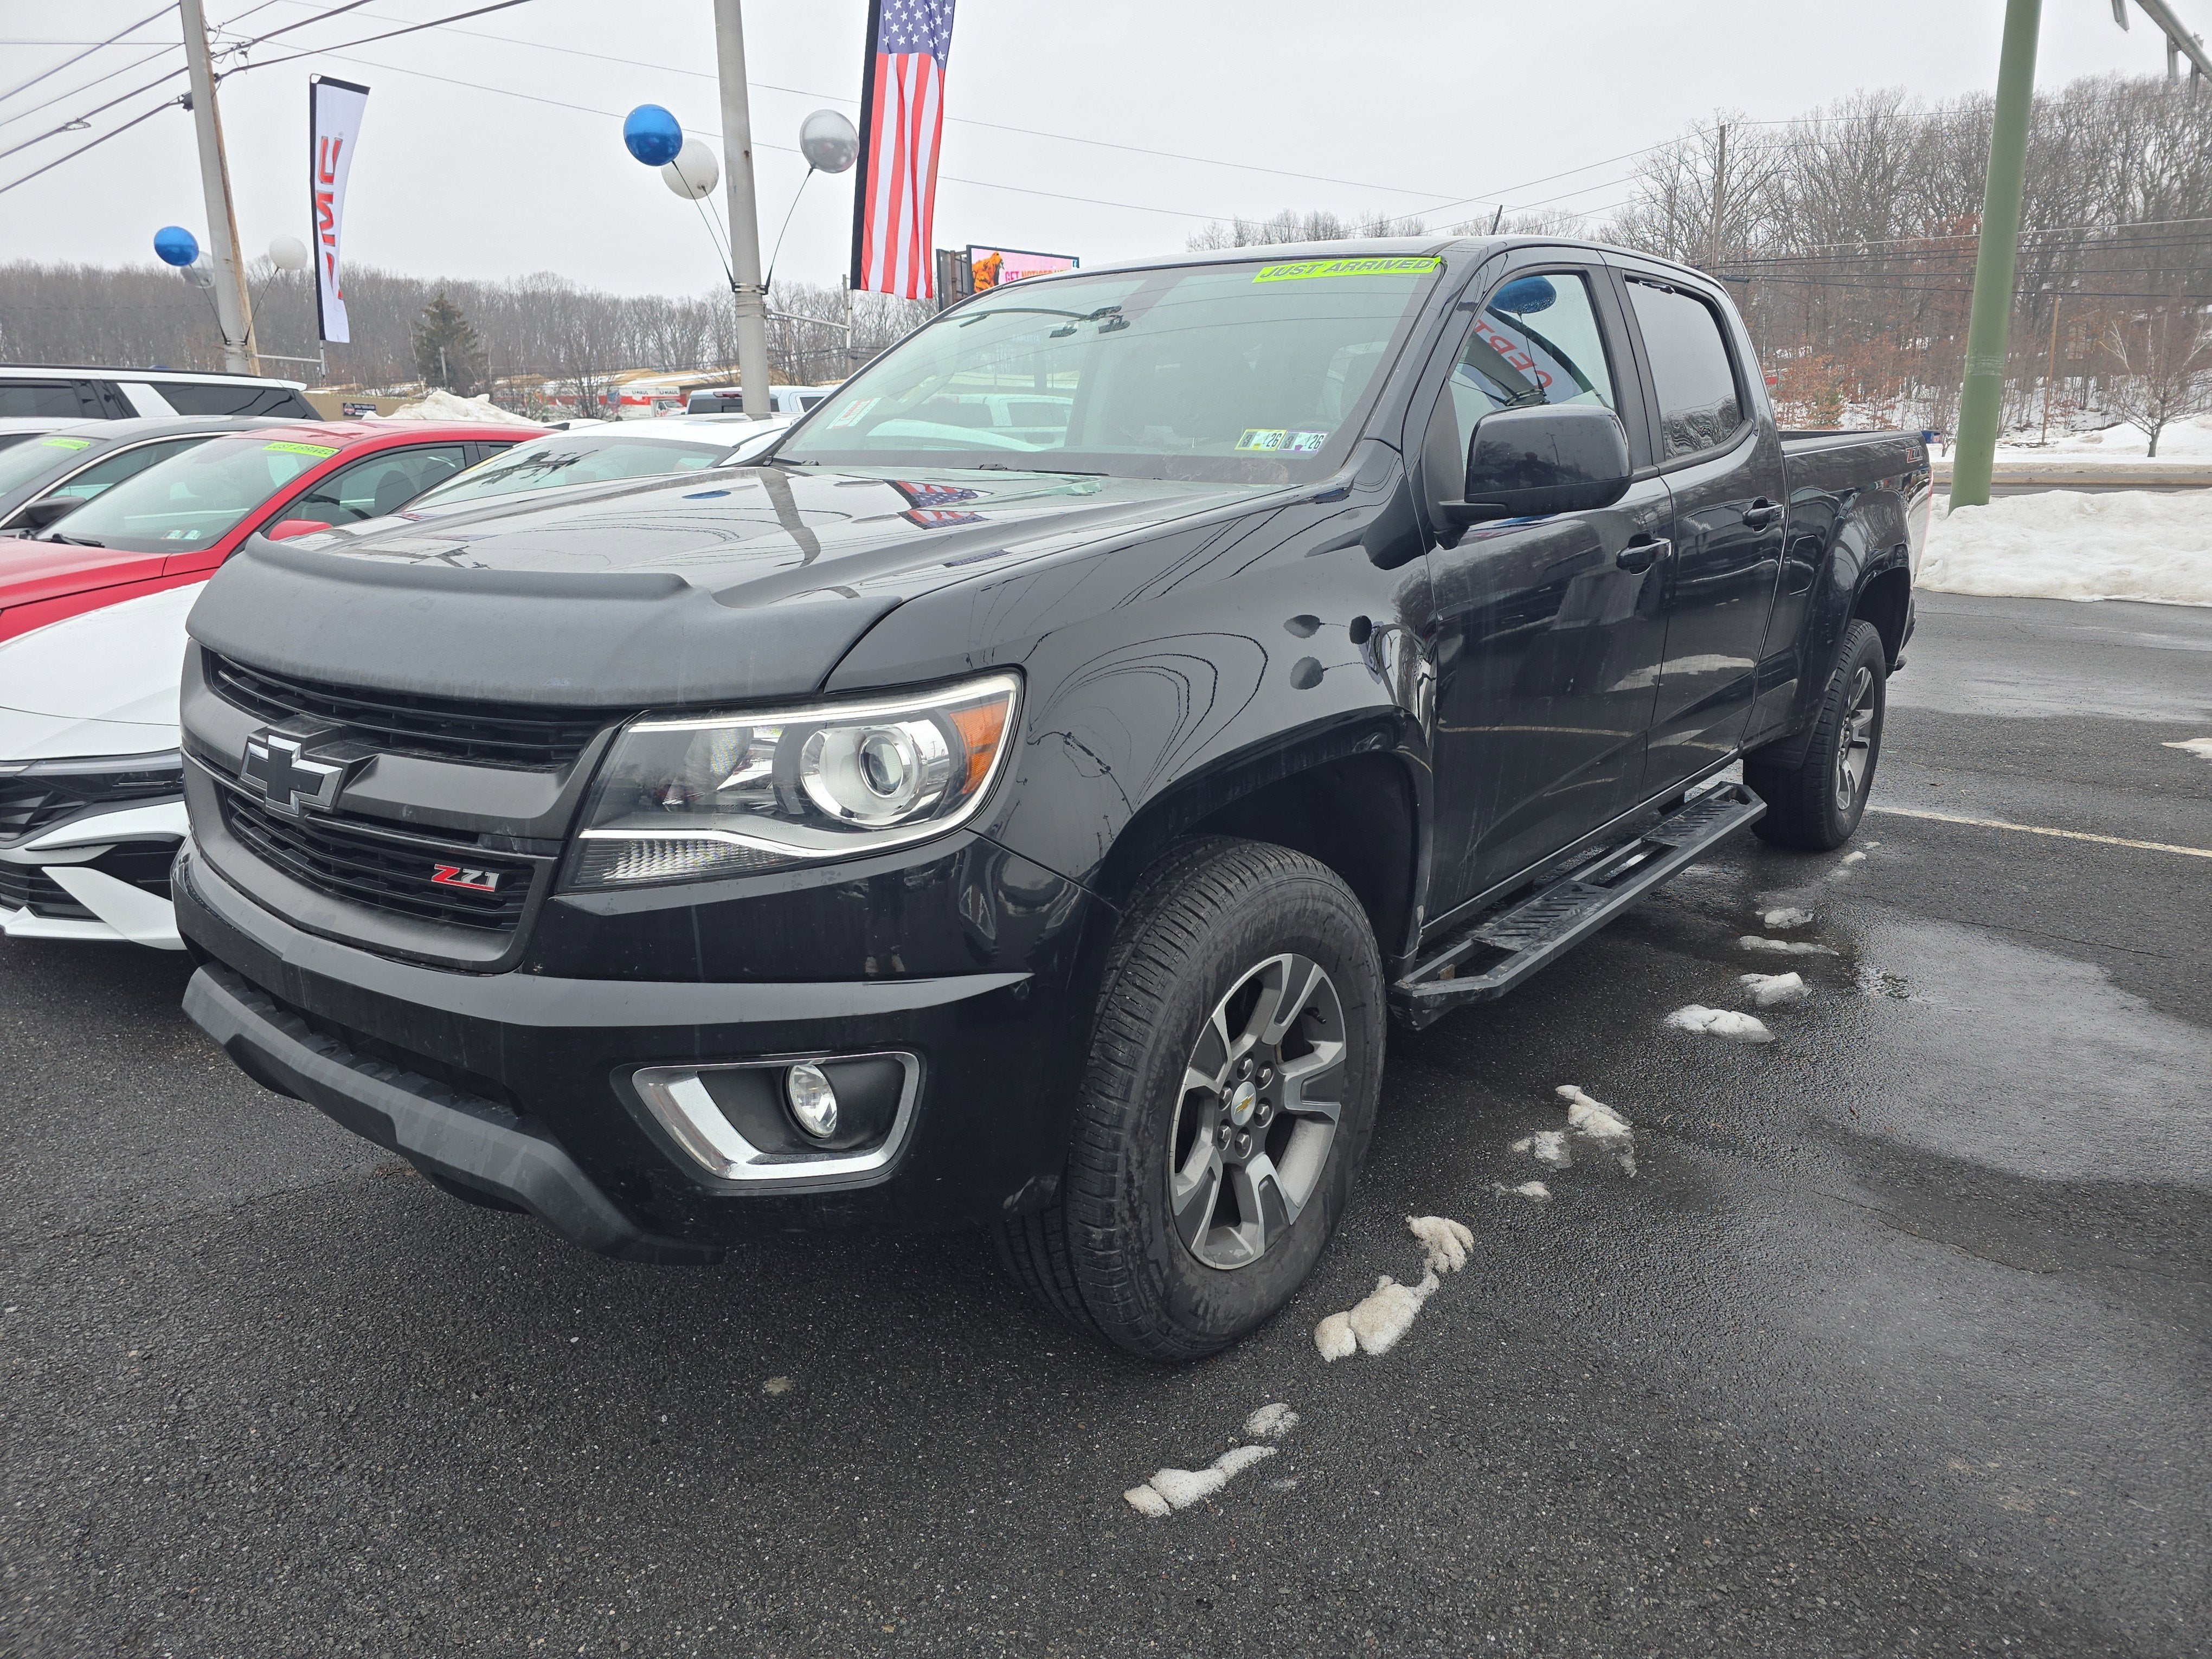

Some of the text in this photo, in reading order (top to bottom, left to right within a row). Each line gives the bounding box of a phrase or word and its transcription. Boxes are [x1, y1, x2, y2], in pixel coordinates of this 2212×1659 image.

[1259, 259, 1435, 278] JUST ARRIVED
[1266, 433, 1282, 447] 26
[1283, 434, 1324, 449] 3 26
[1906, 446, 1923, 463] Z71
[432, 864, 500, 892] Z71
